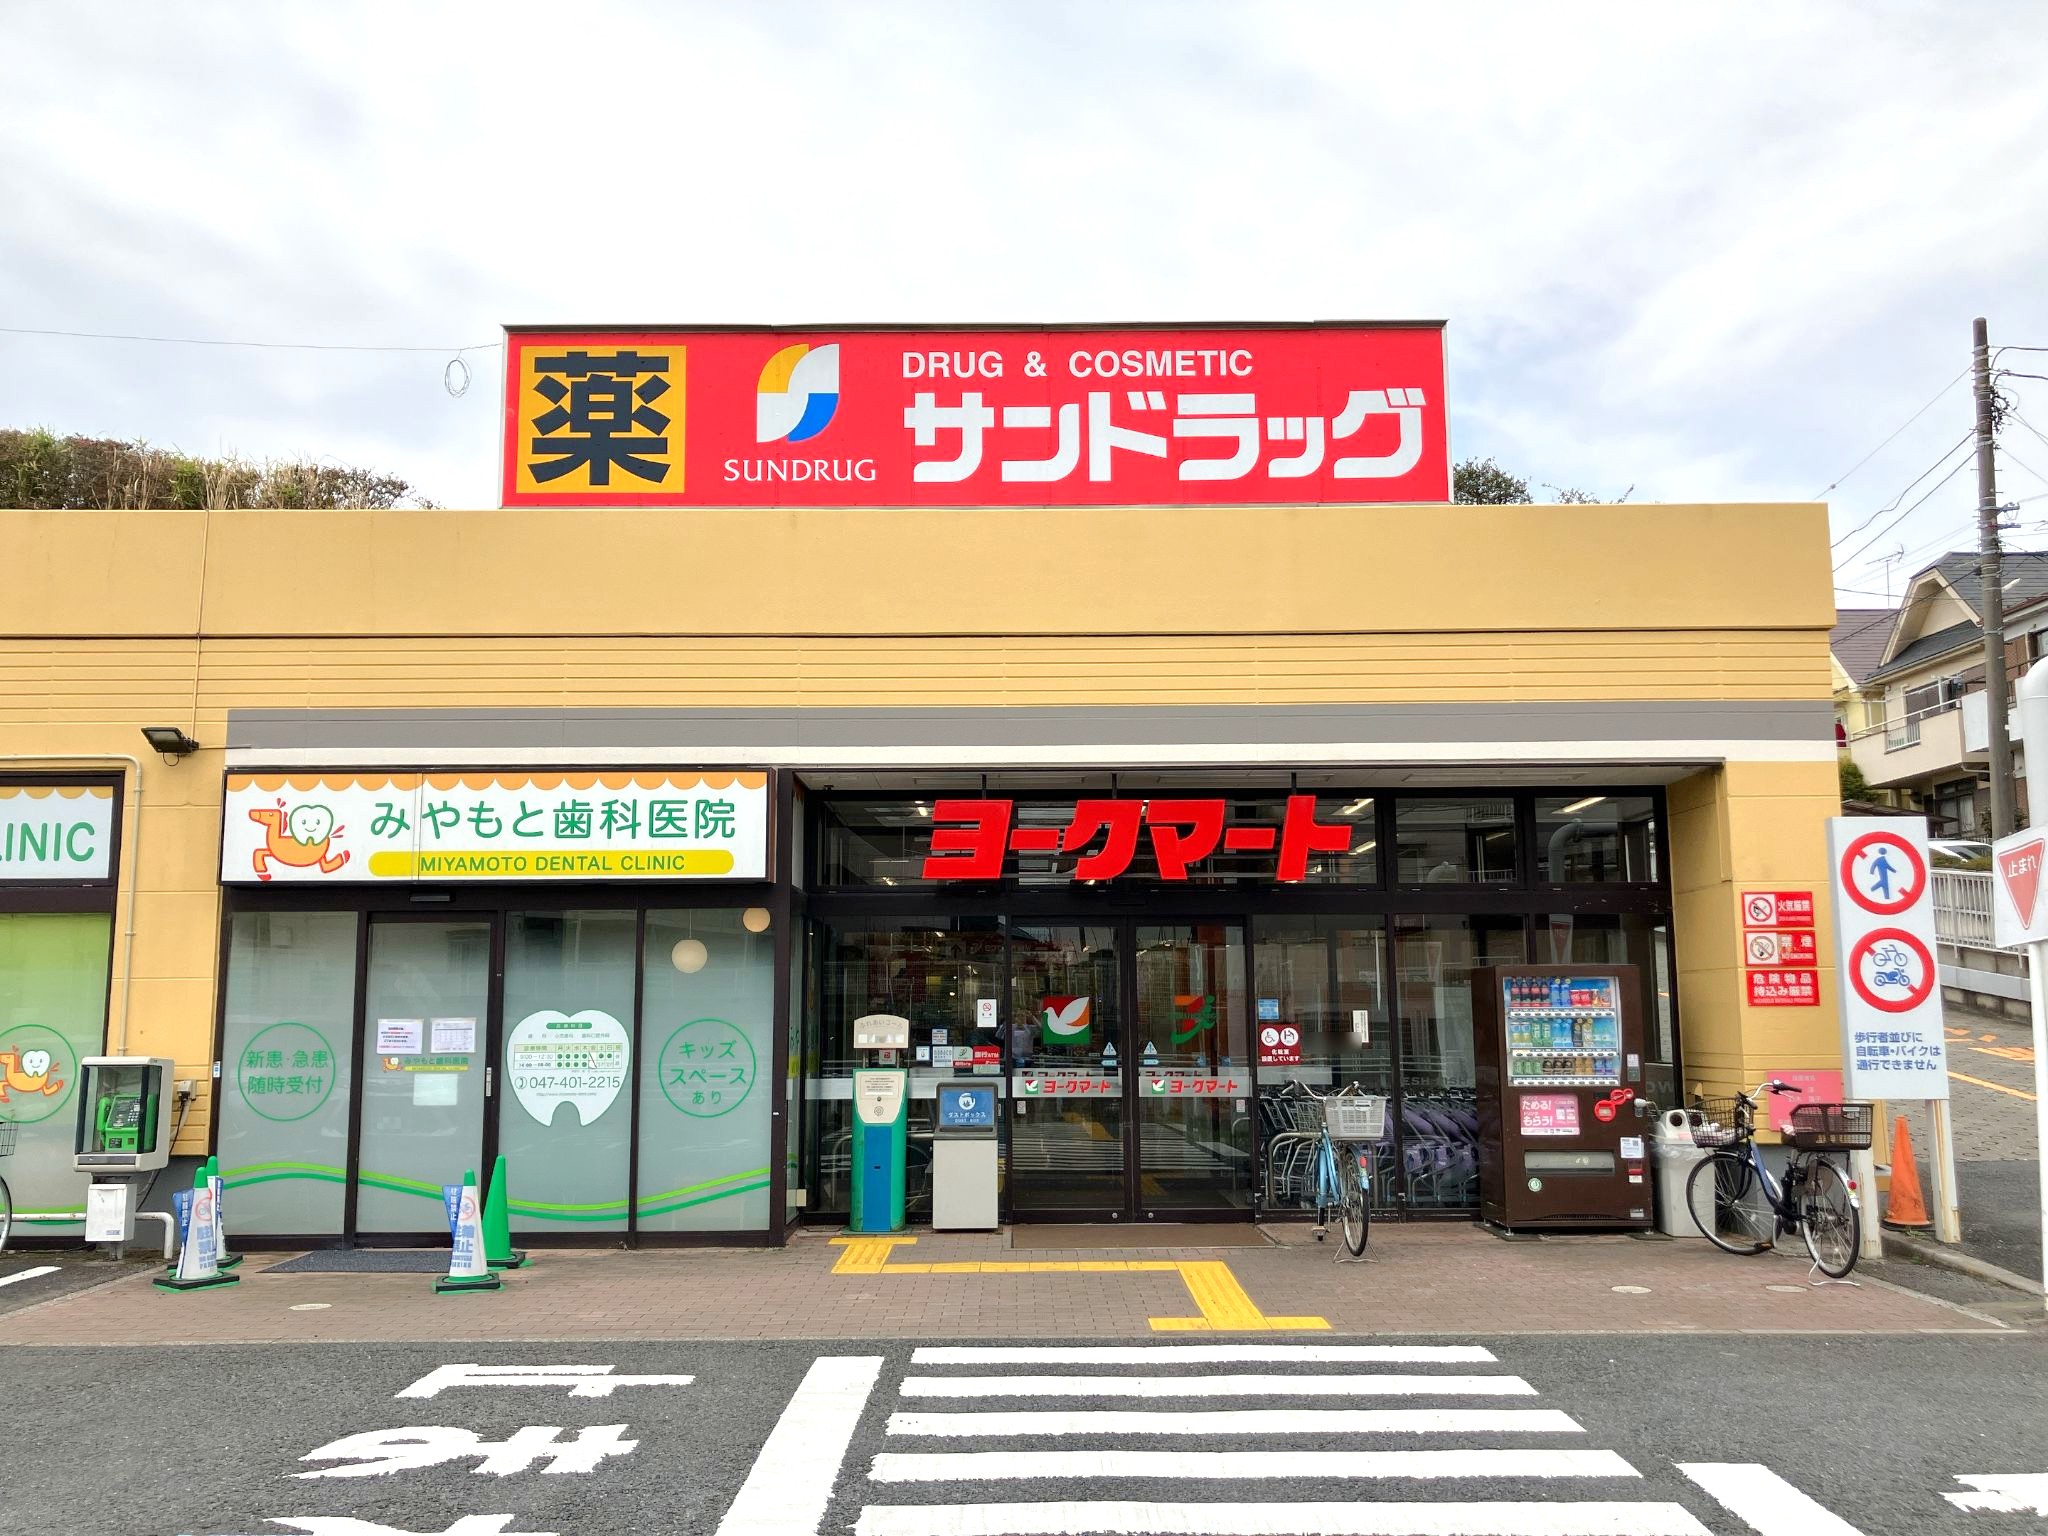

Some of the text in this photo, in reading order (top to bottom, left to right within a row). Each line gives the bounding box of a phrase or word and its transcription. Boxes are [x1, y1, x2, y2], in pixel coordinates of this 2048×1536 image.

[903, 350, 1253, 379] DRUG & COSMETIC
[527, 352, 671, 485] 薬
[904, 387, 1427, 482] サンドラッグ
[723, 456, 876, 482] SUNDRUG
[370, 799, 736, 840] みやもと歯科医院
[0, 821, 96, 862] INIC
[921, 795, 1353, 882] ヨークマート
[420, 854, 685, 872] MIYAMOTO DENTAL CLINIC
[2007, 855, 2037, 878] 止まれ
[1854, 1031, 1923, 1043] 歩行者並びに
[679, 1040, 737, 1059] キッズ
[1856, 1045, 1941, 1056] 自転車・バイクは
[1857, 1060, 1936, 1071] 通行できません
[248, 1075, 323, 1095] 随時受付
[529, 1076, 620, 1089] 047-401-2215
[669, 1068, 746, 1086] スペース
[1043, 1080, 1111, 1094] ヨークマート
[1169, 1080, 1238, 1094] ヨークマート
[692, 1091, 721, 1105] あり
